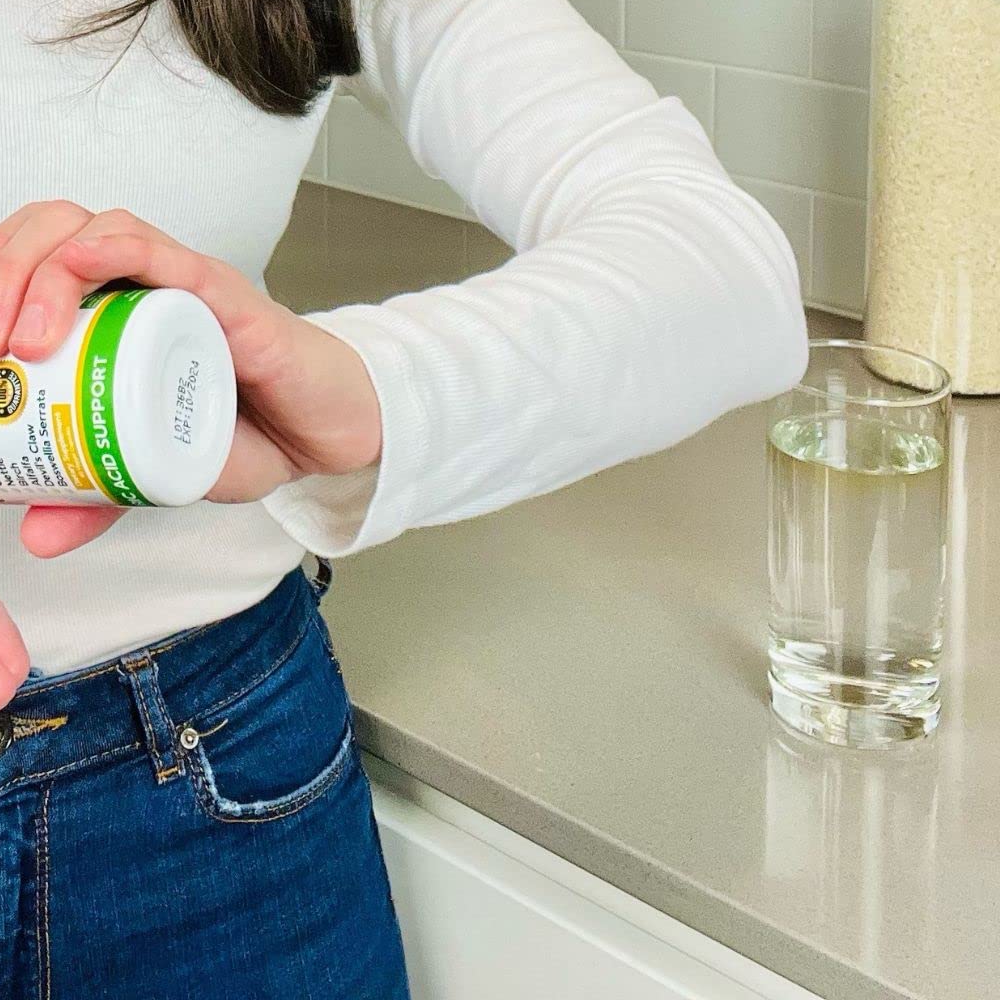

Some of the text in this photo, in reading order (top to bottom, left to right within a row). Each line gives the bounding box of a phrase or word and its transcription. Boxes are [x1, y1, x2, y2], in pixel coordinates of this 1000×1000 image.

[7, 371, 21, 414] GUARANTEE
[91, 356, 110, 449] SUPPORT
[27, 424, 55, 487] Devil's Claw
[36, 389, 68, 487] Boswellia Serrata
[10, 462, 29, 487] Birch
[21, 456, 41, 486] Alfalfa
[102, 453, 129, 489] ACID
